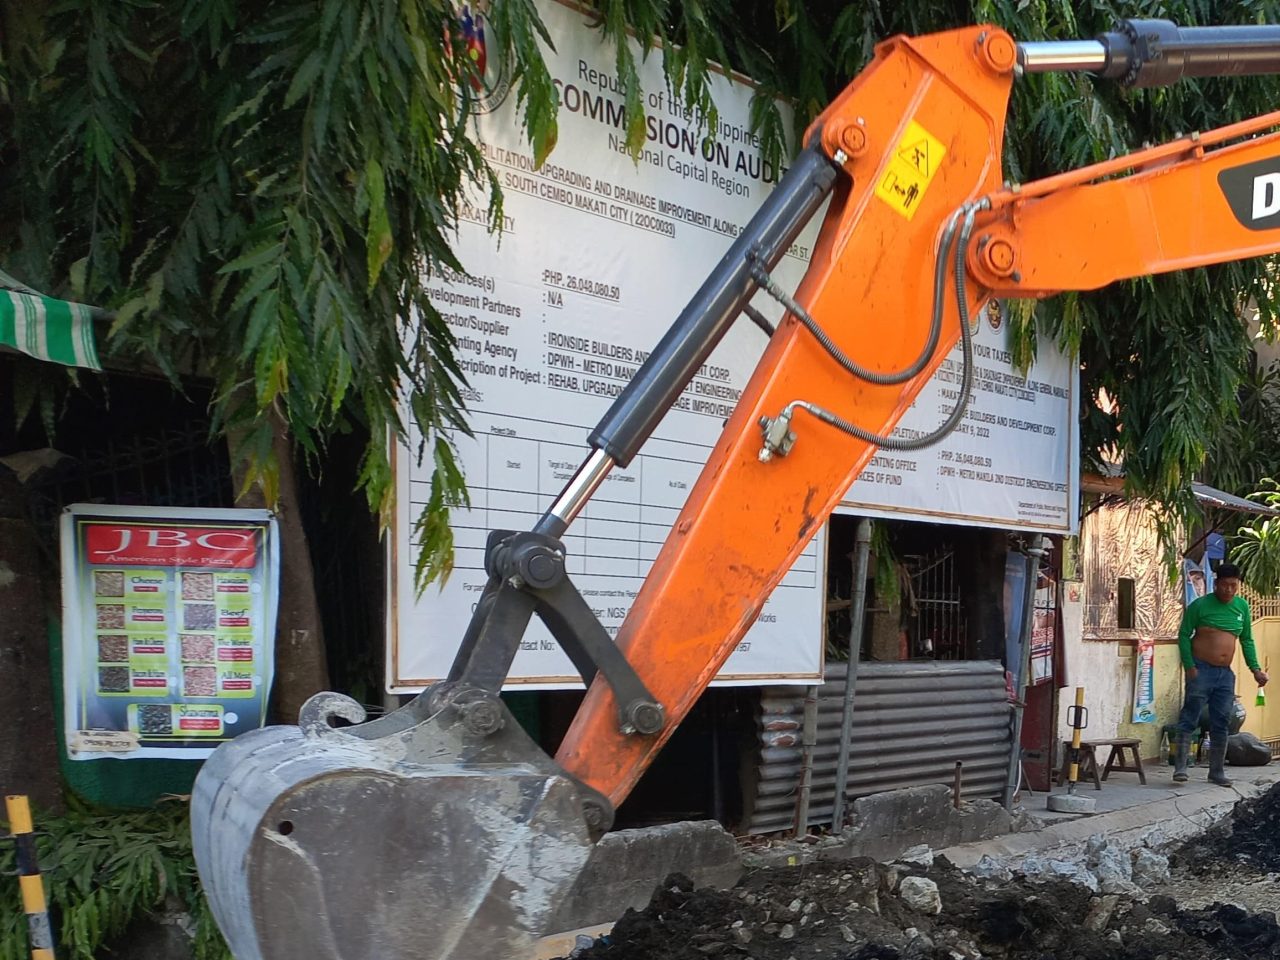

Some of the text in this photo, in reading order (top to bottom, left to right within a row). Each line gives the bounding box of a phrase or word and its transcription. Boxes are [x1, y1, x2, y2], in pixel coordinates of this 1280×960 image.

[579, 60, 764, 151] Repub of the Phlippines
[551, 78, 788, 184] COMMSION ON AUD
[608, 133, 750, 198] Naonal Capital Region
[505, 172, 538, 195] SOUTH
[540, 184, 573, 205] CEMBO
[575, 193, 608, 216] MAKATI
[609, 204, 630, 222] CITY
[540, 162, 592, 190] UPGRADING
[594, 180, 612, 197] AND
[614, 185, 656, 210] DRAINAGE
[658, 200, 713, 228] IMPROVEMENT
[713, 219, 738, 237] ALONG
[457, 201, 489, 224] AKAT
[424, 286, 521, 318] evelopment Partners
[548, 290, 564, 306] N/A
[484, 340, 518, 361] Agency
[548, 332, 590, 352] IRONSIDE
[592, 339, 633, 361] BUILDERS
[709, 366, 731, 381] CORP.
[973, 342, 991, 359] YOUR
[547, 352, 575, 369] DPWH
[583, 360, 613, 376] METRO
[457, 358, 496, 376] scription
[500, 365, 508, 377] of
[510, 367, 541, 384] Project
[547, 373, 581, 393] REHAB,
[582, 379, 625, 399] UPGRADIN
[692, 399, 734, 417] IMPROVEME
[458, 387, 484, 402] etails:
[976, 427, 990, 438] 2022
[997, 417, 1008, 427] AND
[895, 460, 917, 471] OFFICE
[876, 474, 885, 483] OF
[885, 474, 903, 485] FUND
[93, 529, 250, 554] JBC
[105, 554, 233, 566] American Style Pizza
[131, 576, 163, 585] Cheese
[220, 608, 249, 618] Beef
[606, 607, 625, 618] NGS
